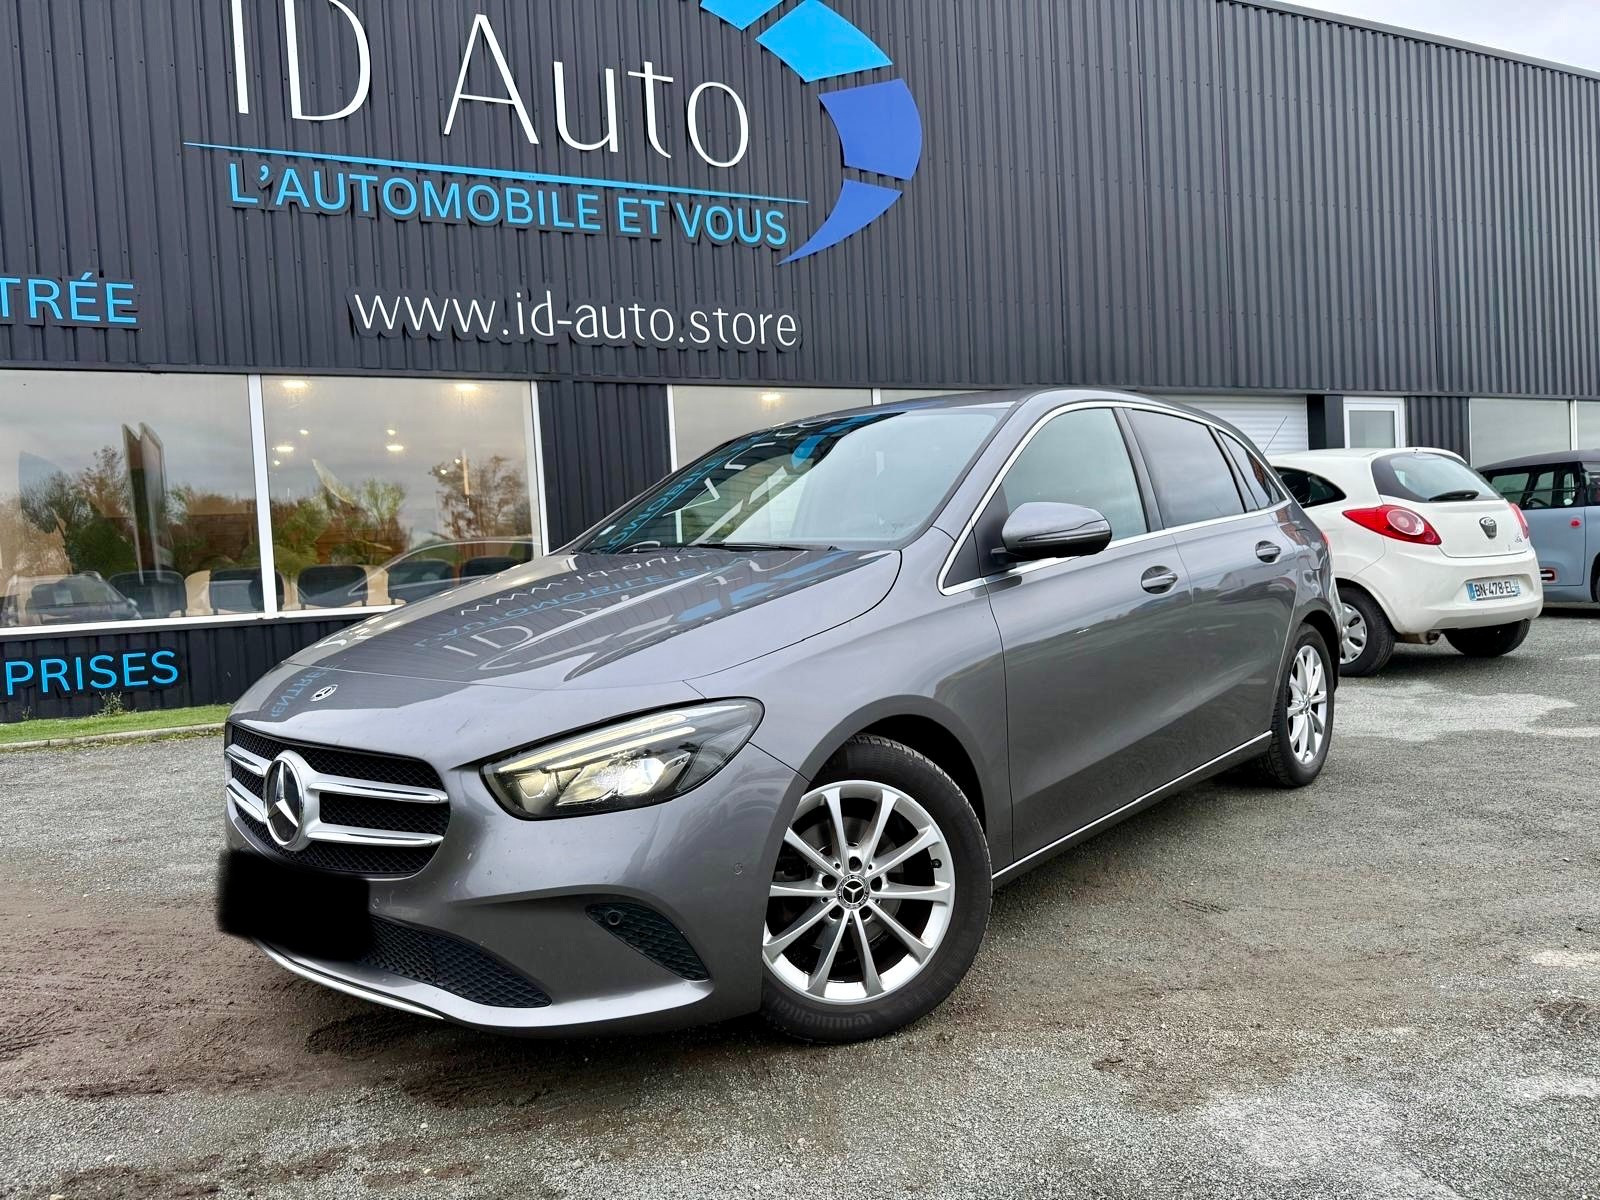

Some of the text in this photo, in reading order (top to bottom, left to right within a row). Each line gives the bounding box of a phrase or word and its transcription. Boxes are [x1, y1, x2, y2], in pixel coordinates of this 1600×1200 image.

[231, 0, 750, 169] ID Auto
[228, 161, 788, 246] L'AUTOMOBILE ET VOUS
[353, 290, 798, 348] www.id-auto.store
[1474, 581, 1516, 597] BN-478-EL
[5, 650, 179, 696] PRISES
